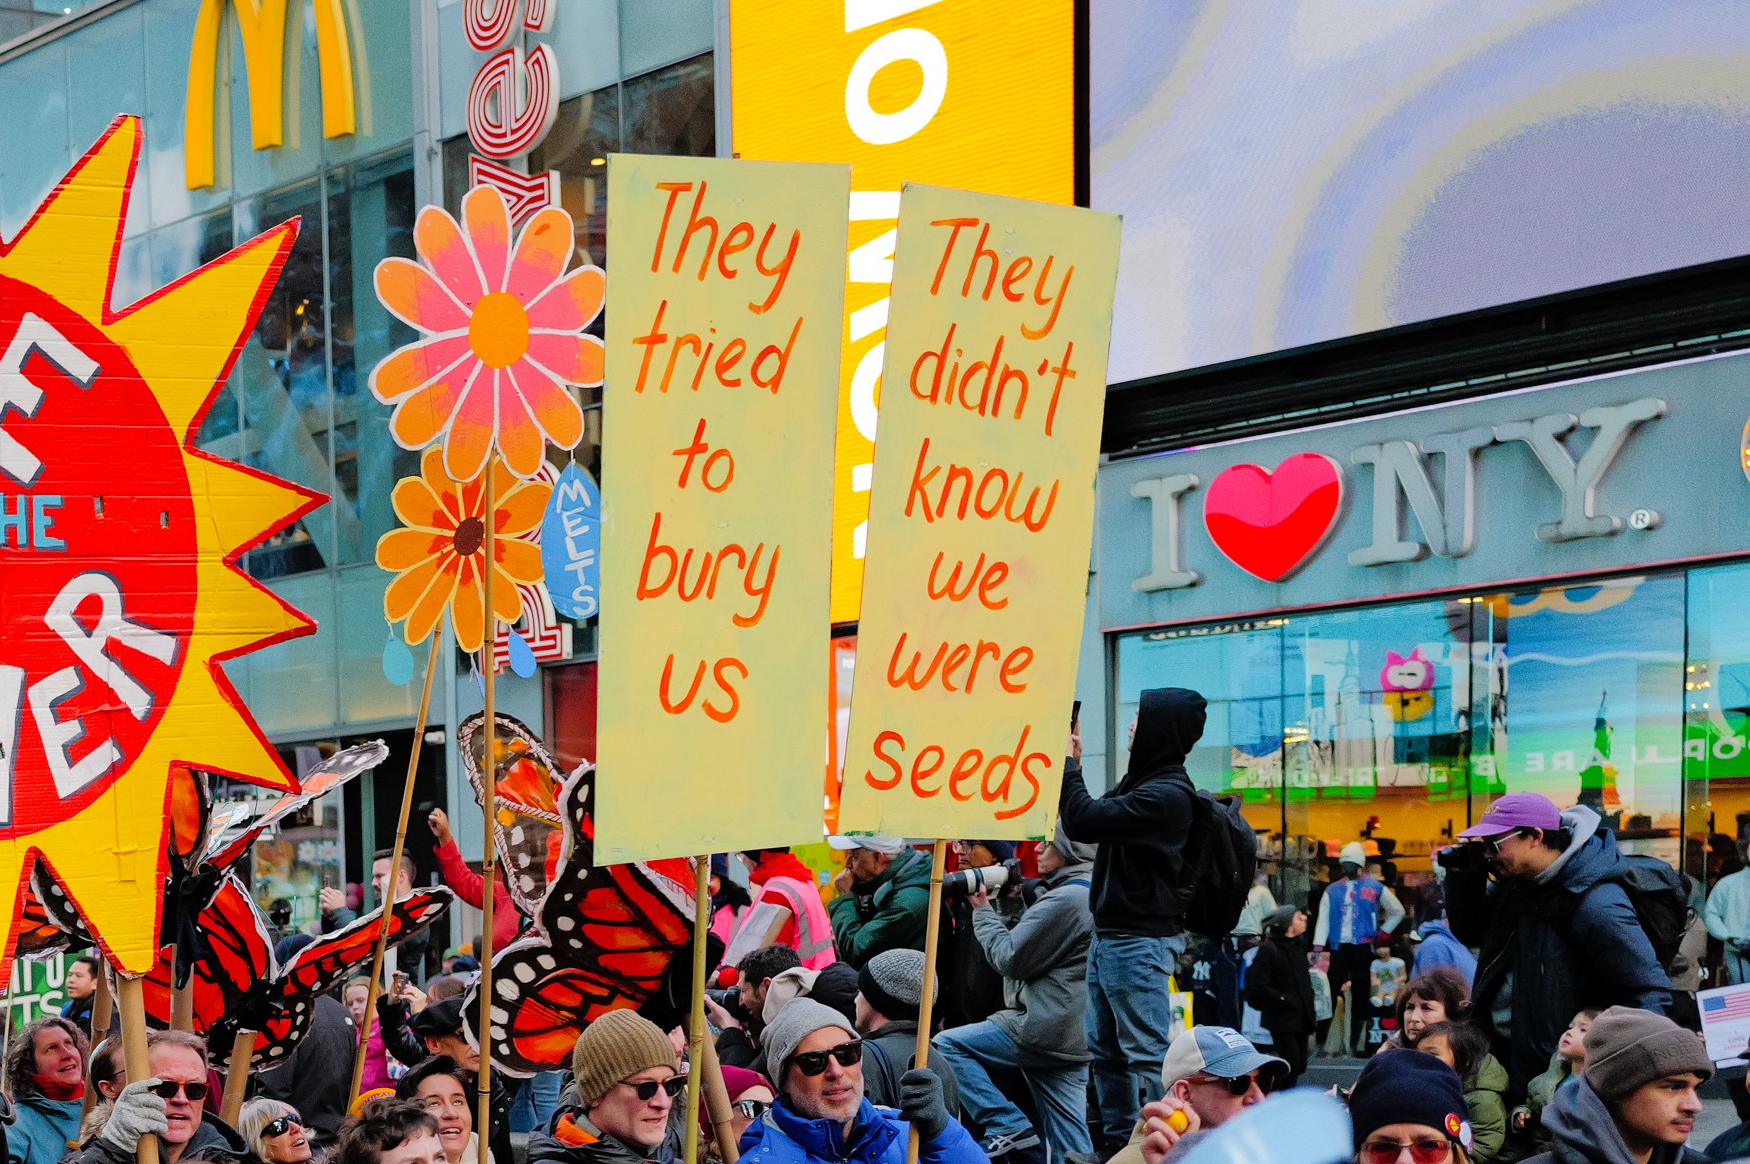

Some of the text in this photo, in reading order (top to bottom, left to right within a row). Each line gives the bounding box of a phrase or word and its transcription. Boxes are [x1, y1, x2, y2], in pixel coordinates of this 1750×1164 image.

[651, 180, 801, 316] They
[928, 217, 1076, 341] They
[630, 299, 804, 396] tried
[909, 322, 1077, 438] didn't
[671, 417, 736, 493] to
[903, 437, 1061, 533] know
[556, 477, 597, 616] MELTS
[635, 511, 782, 628] bury
[925, 549, 1010, 611] we
[1130, 471, 1201, 595] I
[658, 652, 749, 724] us
[885, 632, 1035, 696] were
[864, 725, 1052, 822] seeds
